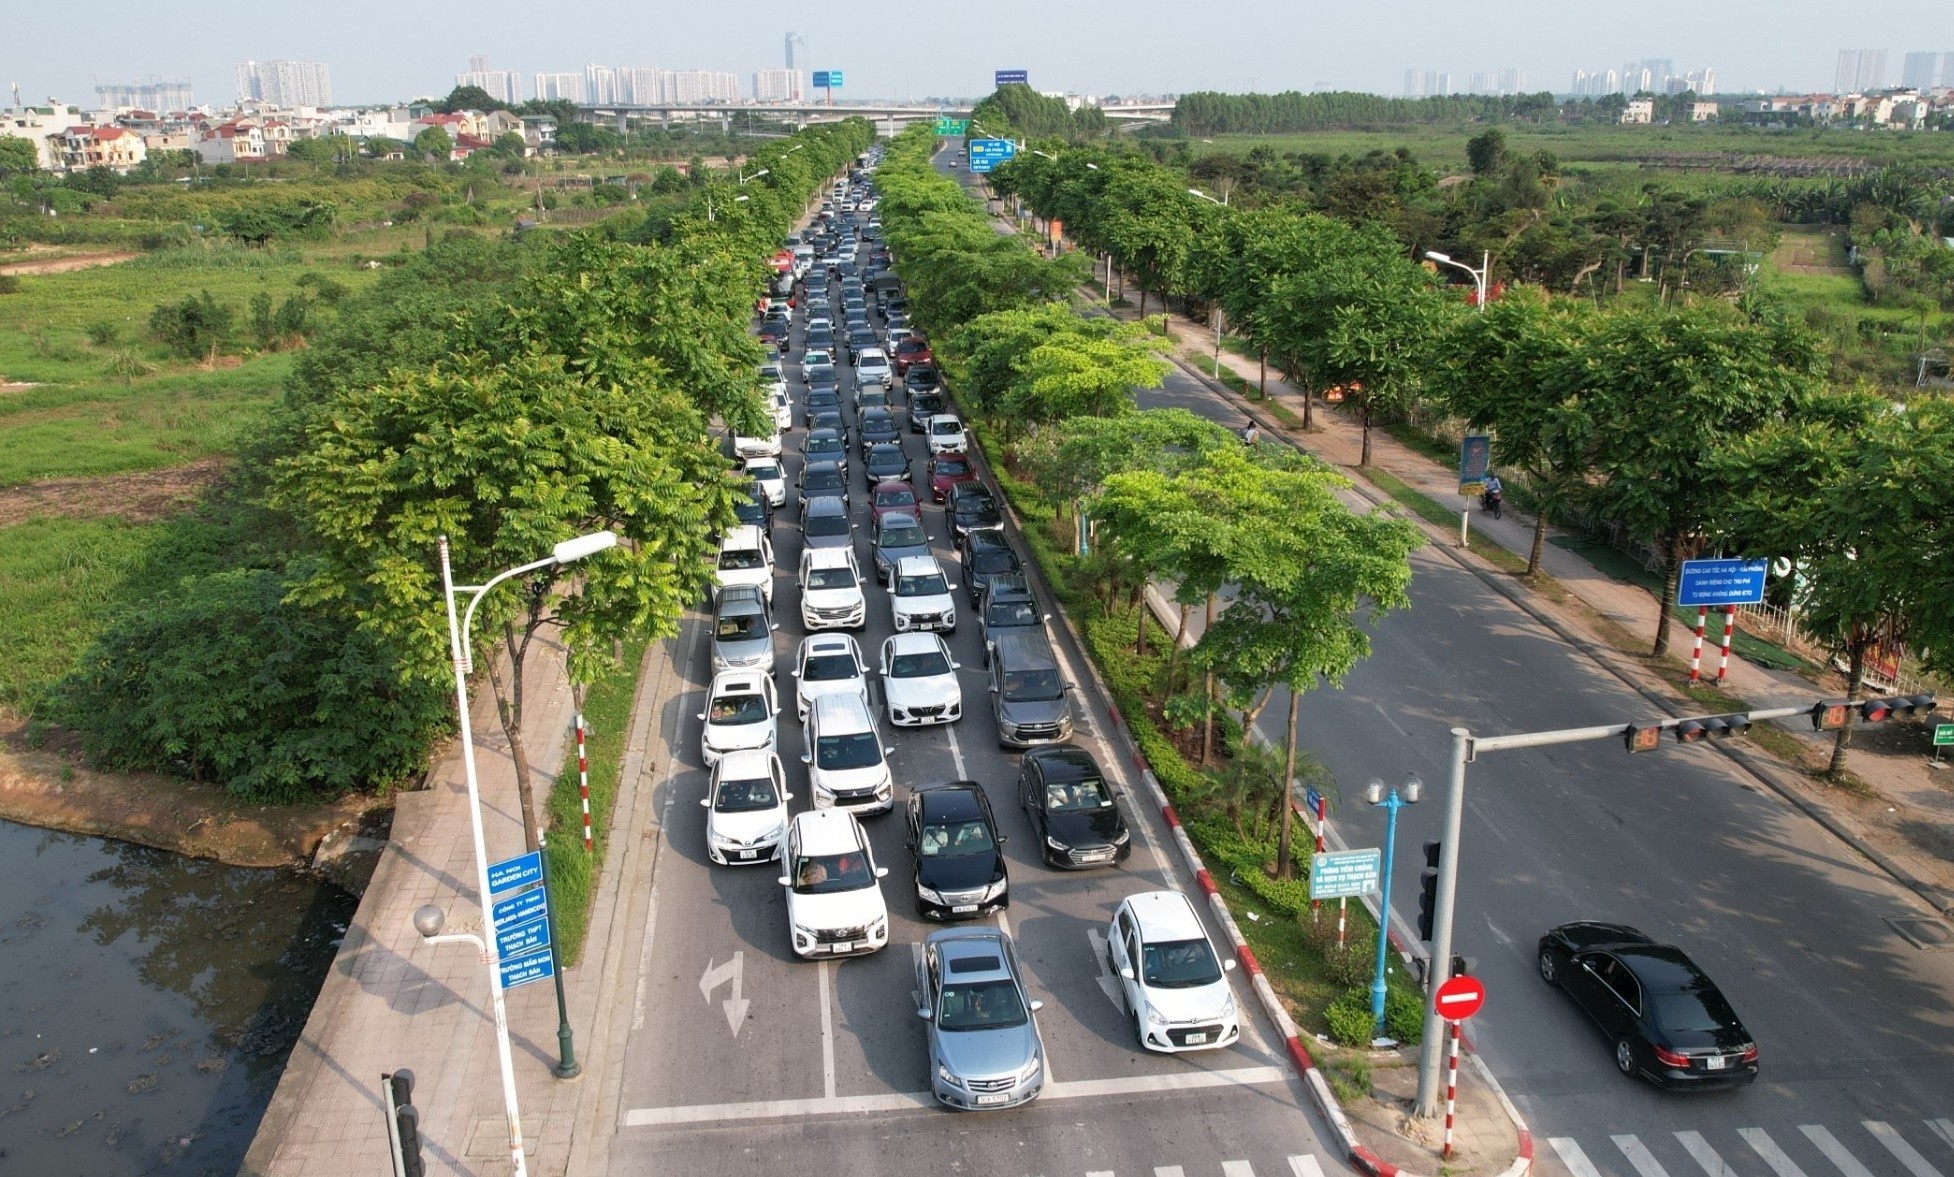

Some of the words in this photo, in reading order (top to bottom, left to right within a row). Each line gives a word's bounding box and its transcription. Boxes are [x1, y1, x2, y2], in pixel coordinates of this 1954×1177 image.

[491, 872, 522, 887] GARDEN
[522, 867, 538, 877] CITY
[528, 925, 542, 934] THPT
